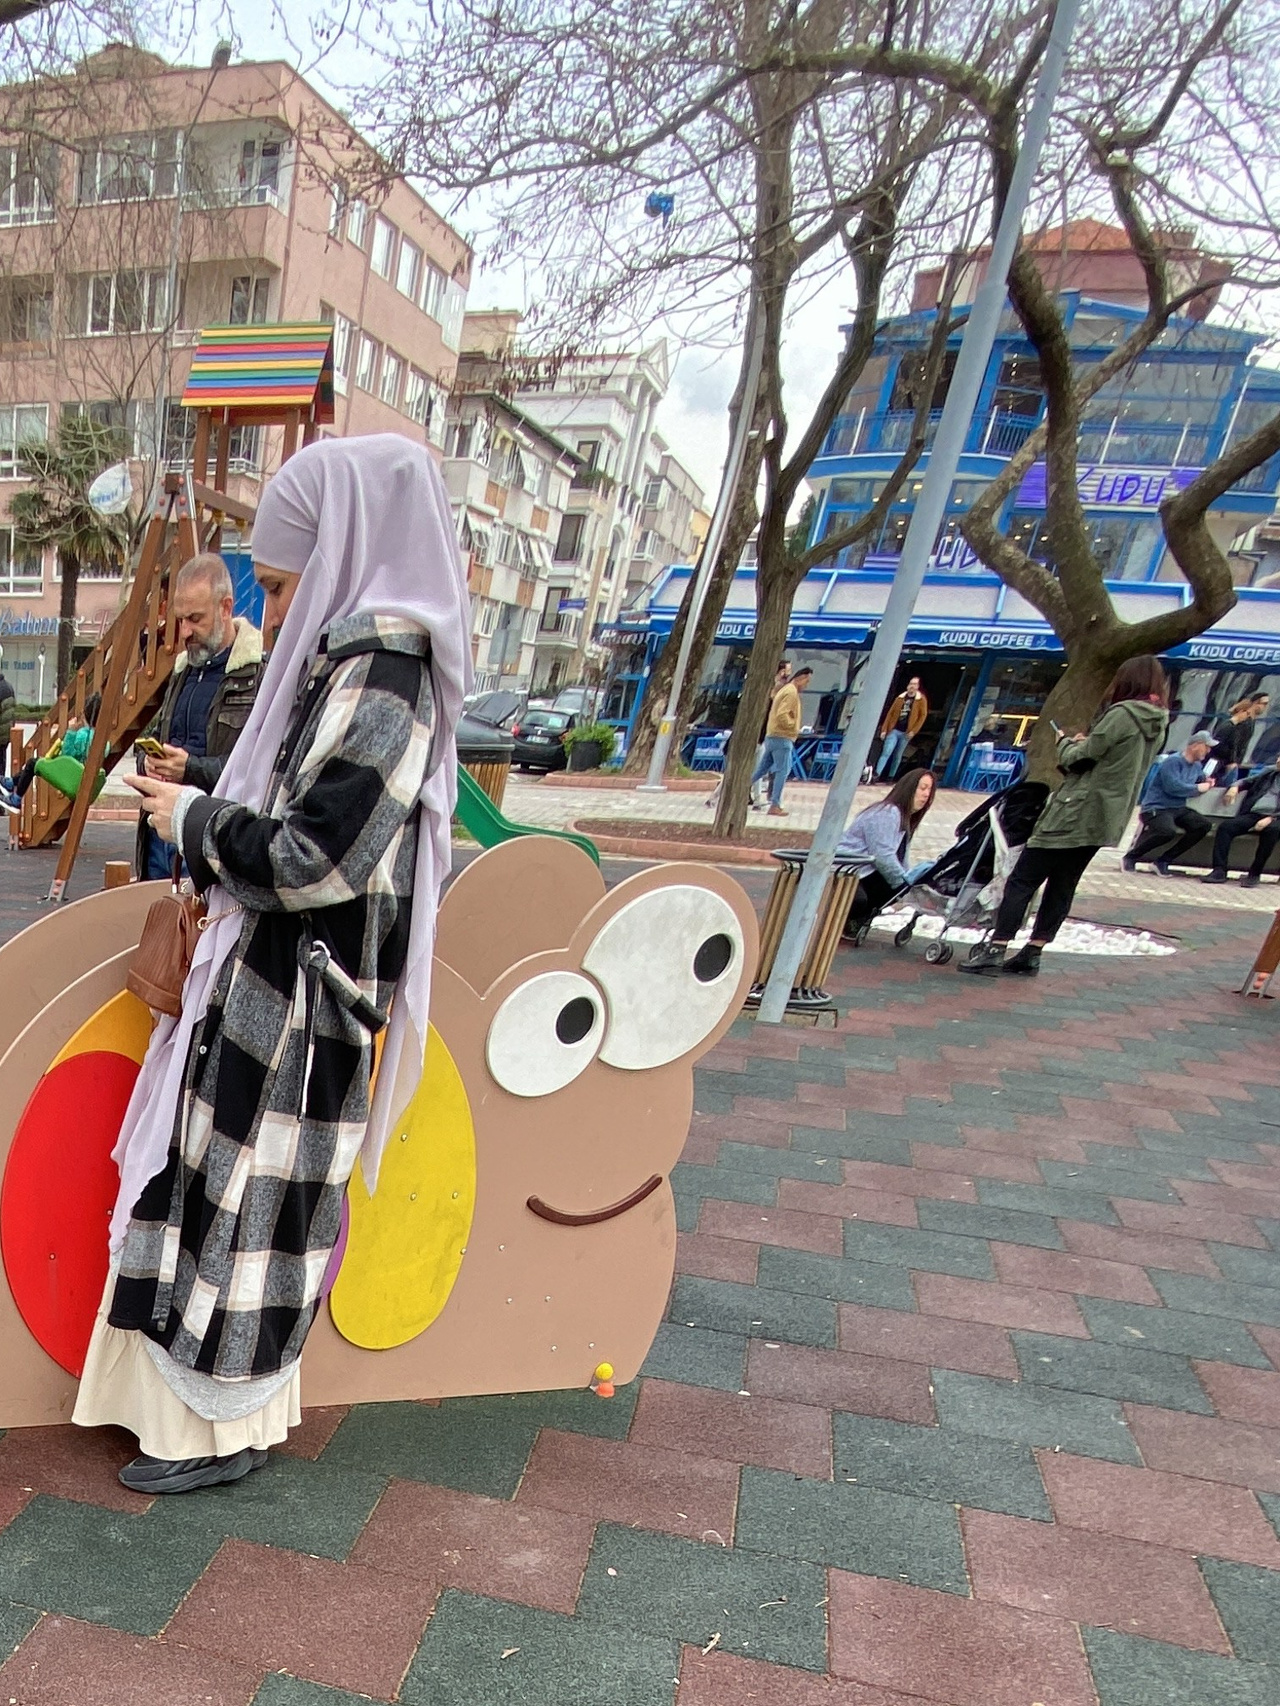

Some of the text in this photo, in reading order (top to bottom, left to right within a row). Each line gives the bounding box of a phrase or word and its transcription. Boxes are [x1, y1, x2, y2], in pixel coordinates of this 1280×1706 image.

[716, 623, 742, 636] UDU
[939, 631, 1035, 647] KUDU COFFEE
[1189, 644, 1232, 659] KUDU
